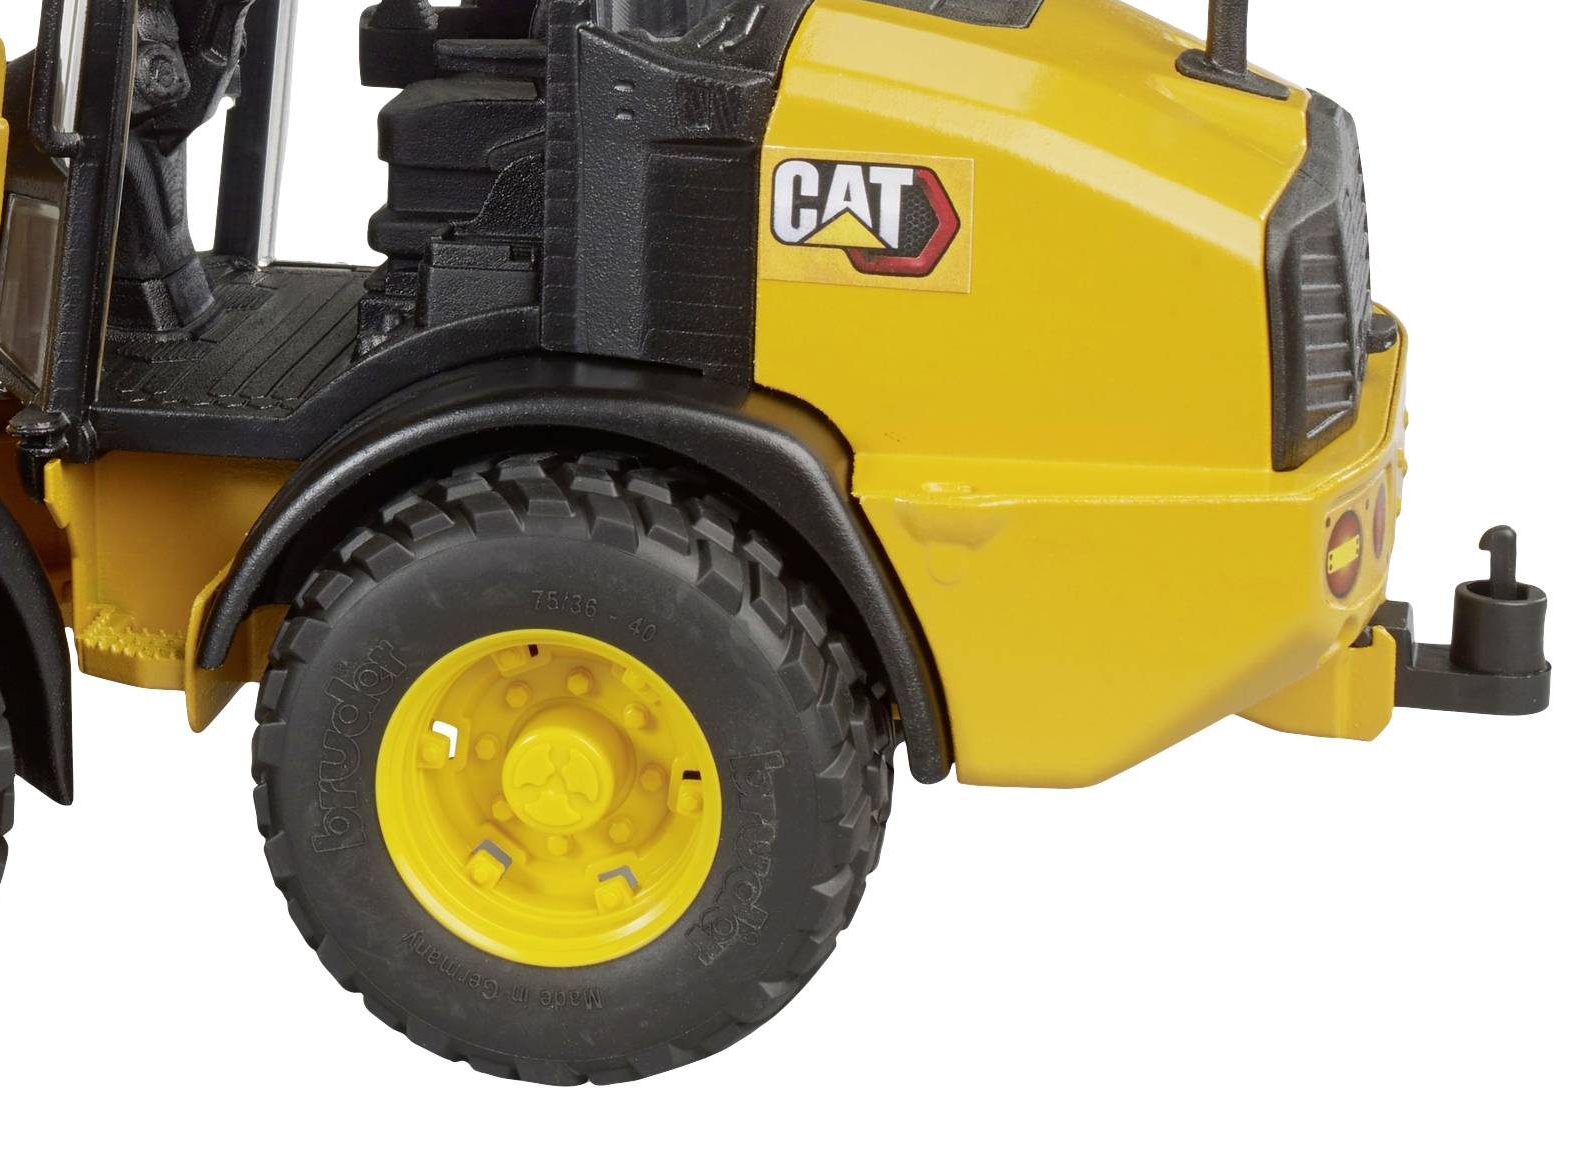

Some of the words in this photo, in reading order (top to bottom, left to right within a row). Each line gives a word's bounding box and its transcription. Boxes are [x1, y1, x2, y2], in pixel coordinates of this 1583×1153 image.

[774, 160, 914, 249] CAT
[530, 589, 598, 618] 75/36
[628, 616, 657, 643] 40
[402, 928, 501, 1001] Germany
[510, 983, 531, 1004] in
[539, 984, 604, 1011] Made
